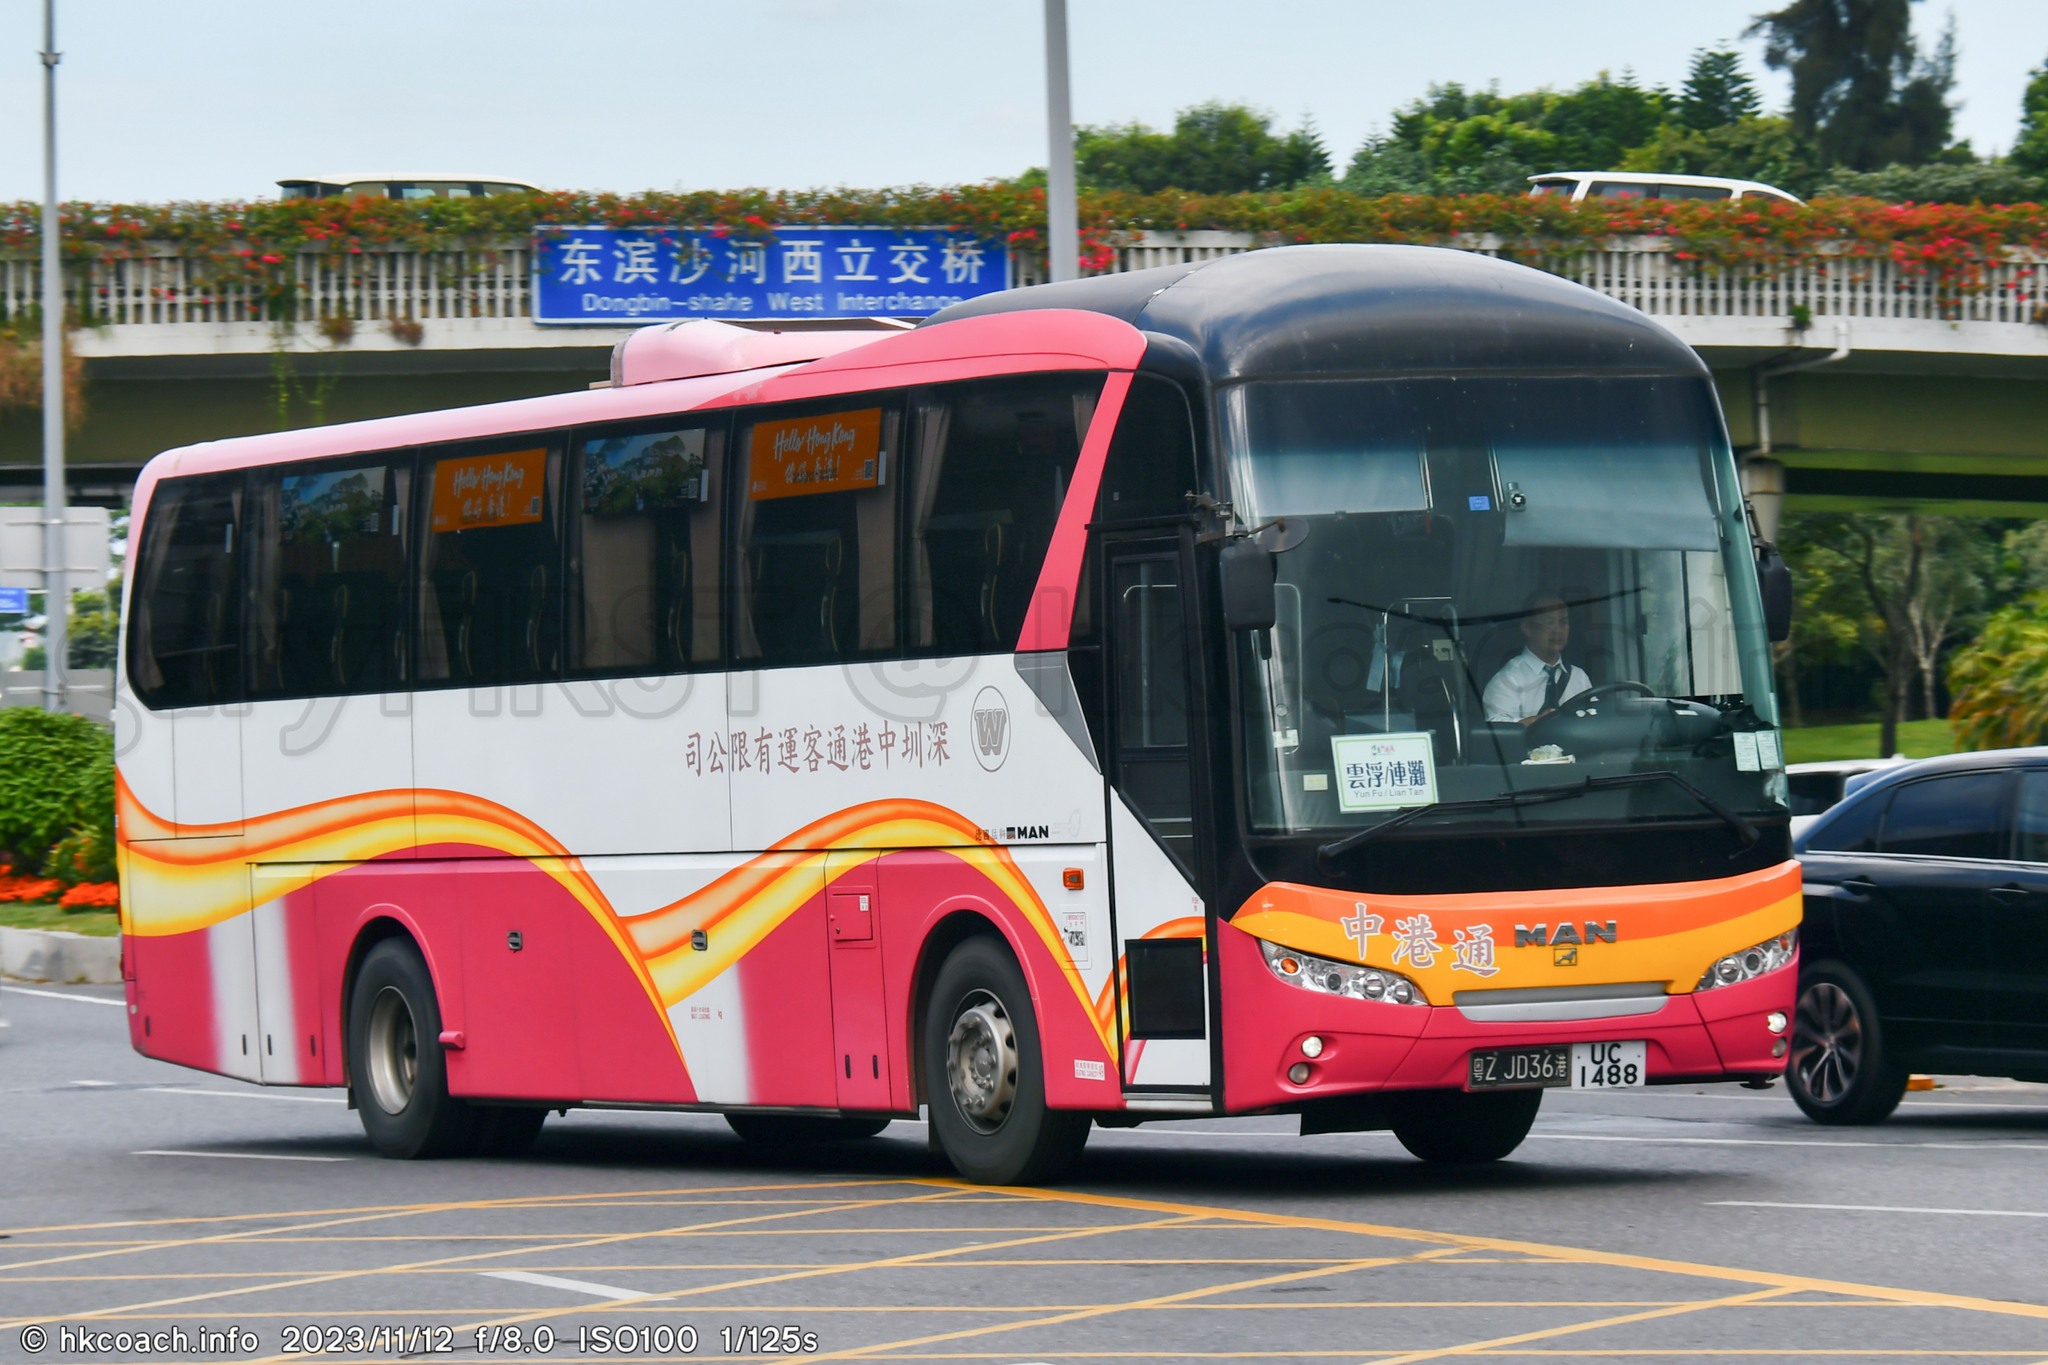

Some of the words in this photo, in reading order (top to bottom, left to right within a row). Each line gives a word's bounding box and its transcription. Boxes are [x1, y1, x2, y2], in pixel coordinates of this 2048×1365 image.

[558, 237, 986, 284] 东滨沙河西立交桥
[581, 292, 753, 315] Dongbin-shahe
[766, 292, 824, 311] West
[1353, 790, 1370, 798] Yun
[1372, 789, 1383, 797] Fu
[1389, 788, 1407, 797] Lian
[1408, 787, 1424, 796] Tan
[1017, 825, 1049, 839] MAN
[1340, 902, 1500, 978] 中港通
[1514, 920, 1617, 947] MAN
[1591, 1043, 1622, 1065] UC
[1580, 1064, 1638, 1087] 1488
